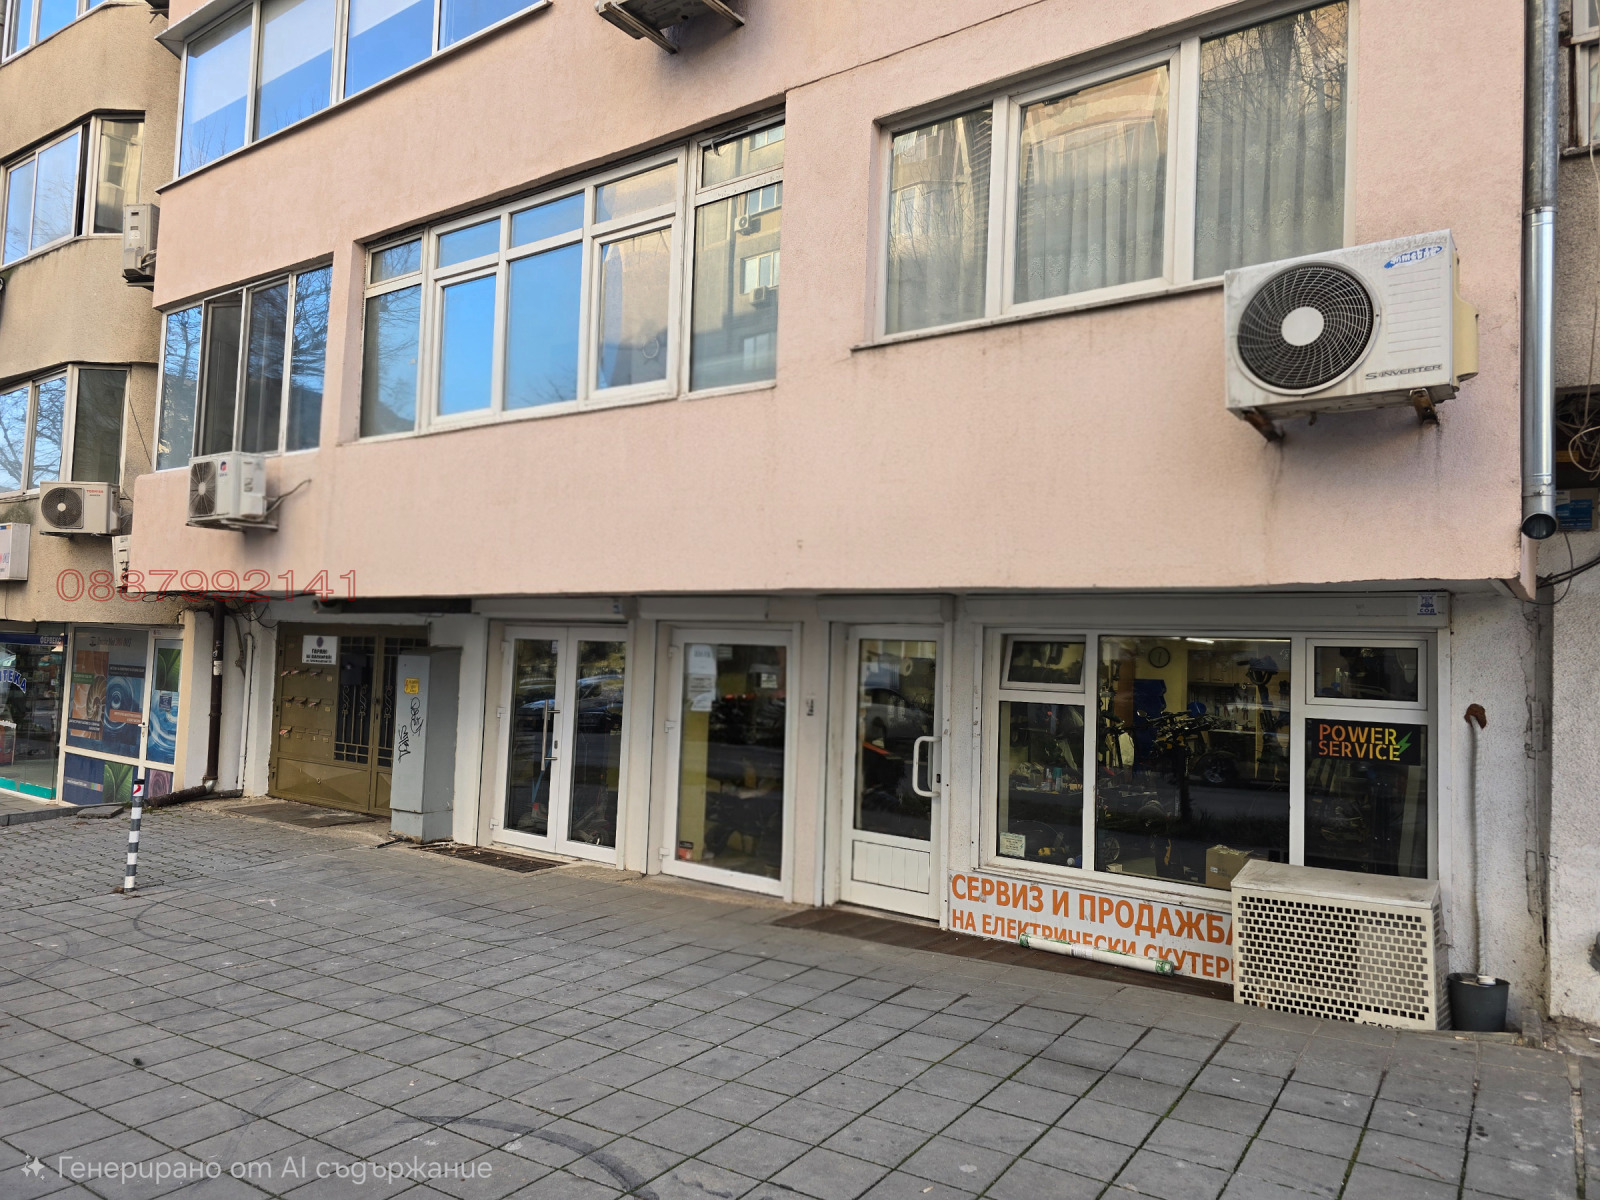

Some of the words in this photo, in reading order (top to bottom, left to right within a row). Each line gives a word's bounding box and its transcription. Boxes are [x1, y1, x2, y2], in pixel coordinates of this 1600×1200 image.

[1318, 740, 1401, 761] SERVICE
[1319, 723, 1397, 745] POWER
[951, 873, 1044, 912] СЕРВИЗ
[1052, 889, 1069, 917] И
[952, 908, 977, 933] НА
[982, 913, 1136, 955] ЕЛЕКТРИЧЕСКИ
[1143, 942, 1234, 981] СКУТЕР
